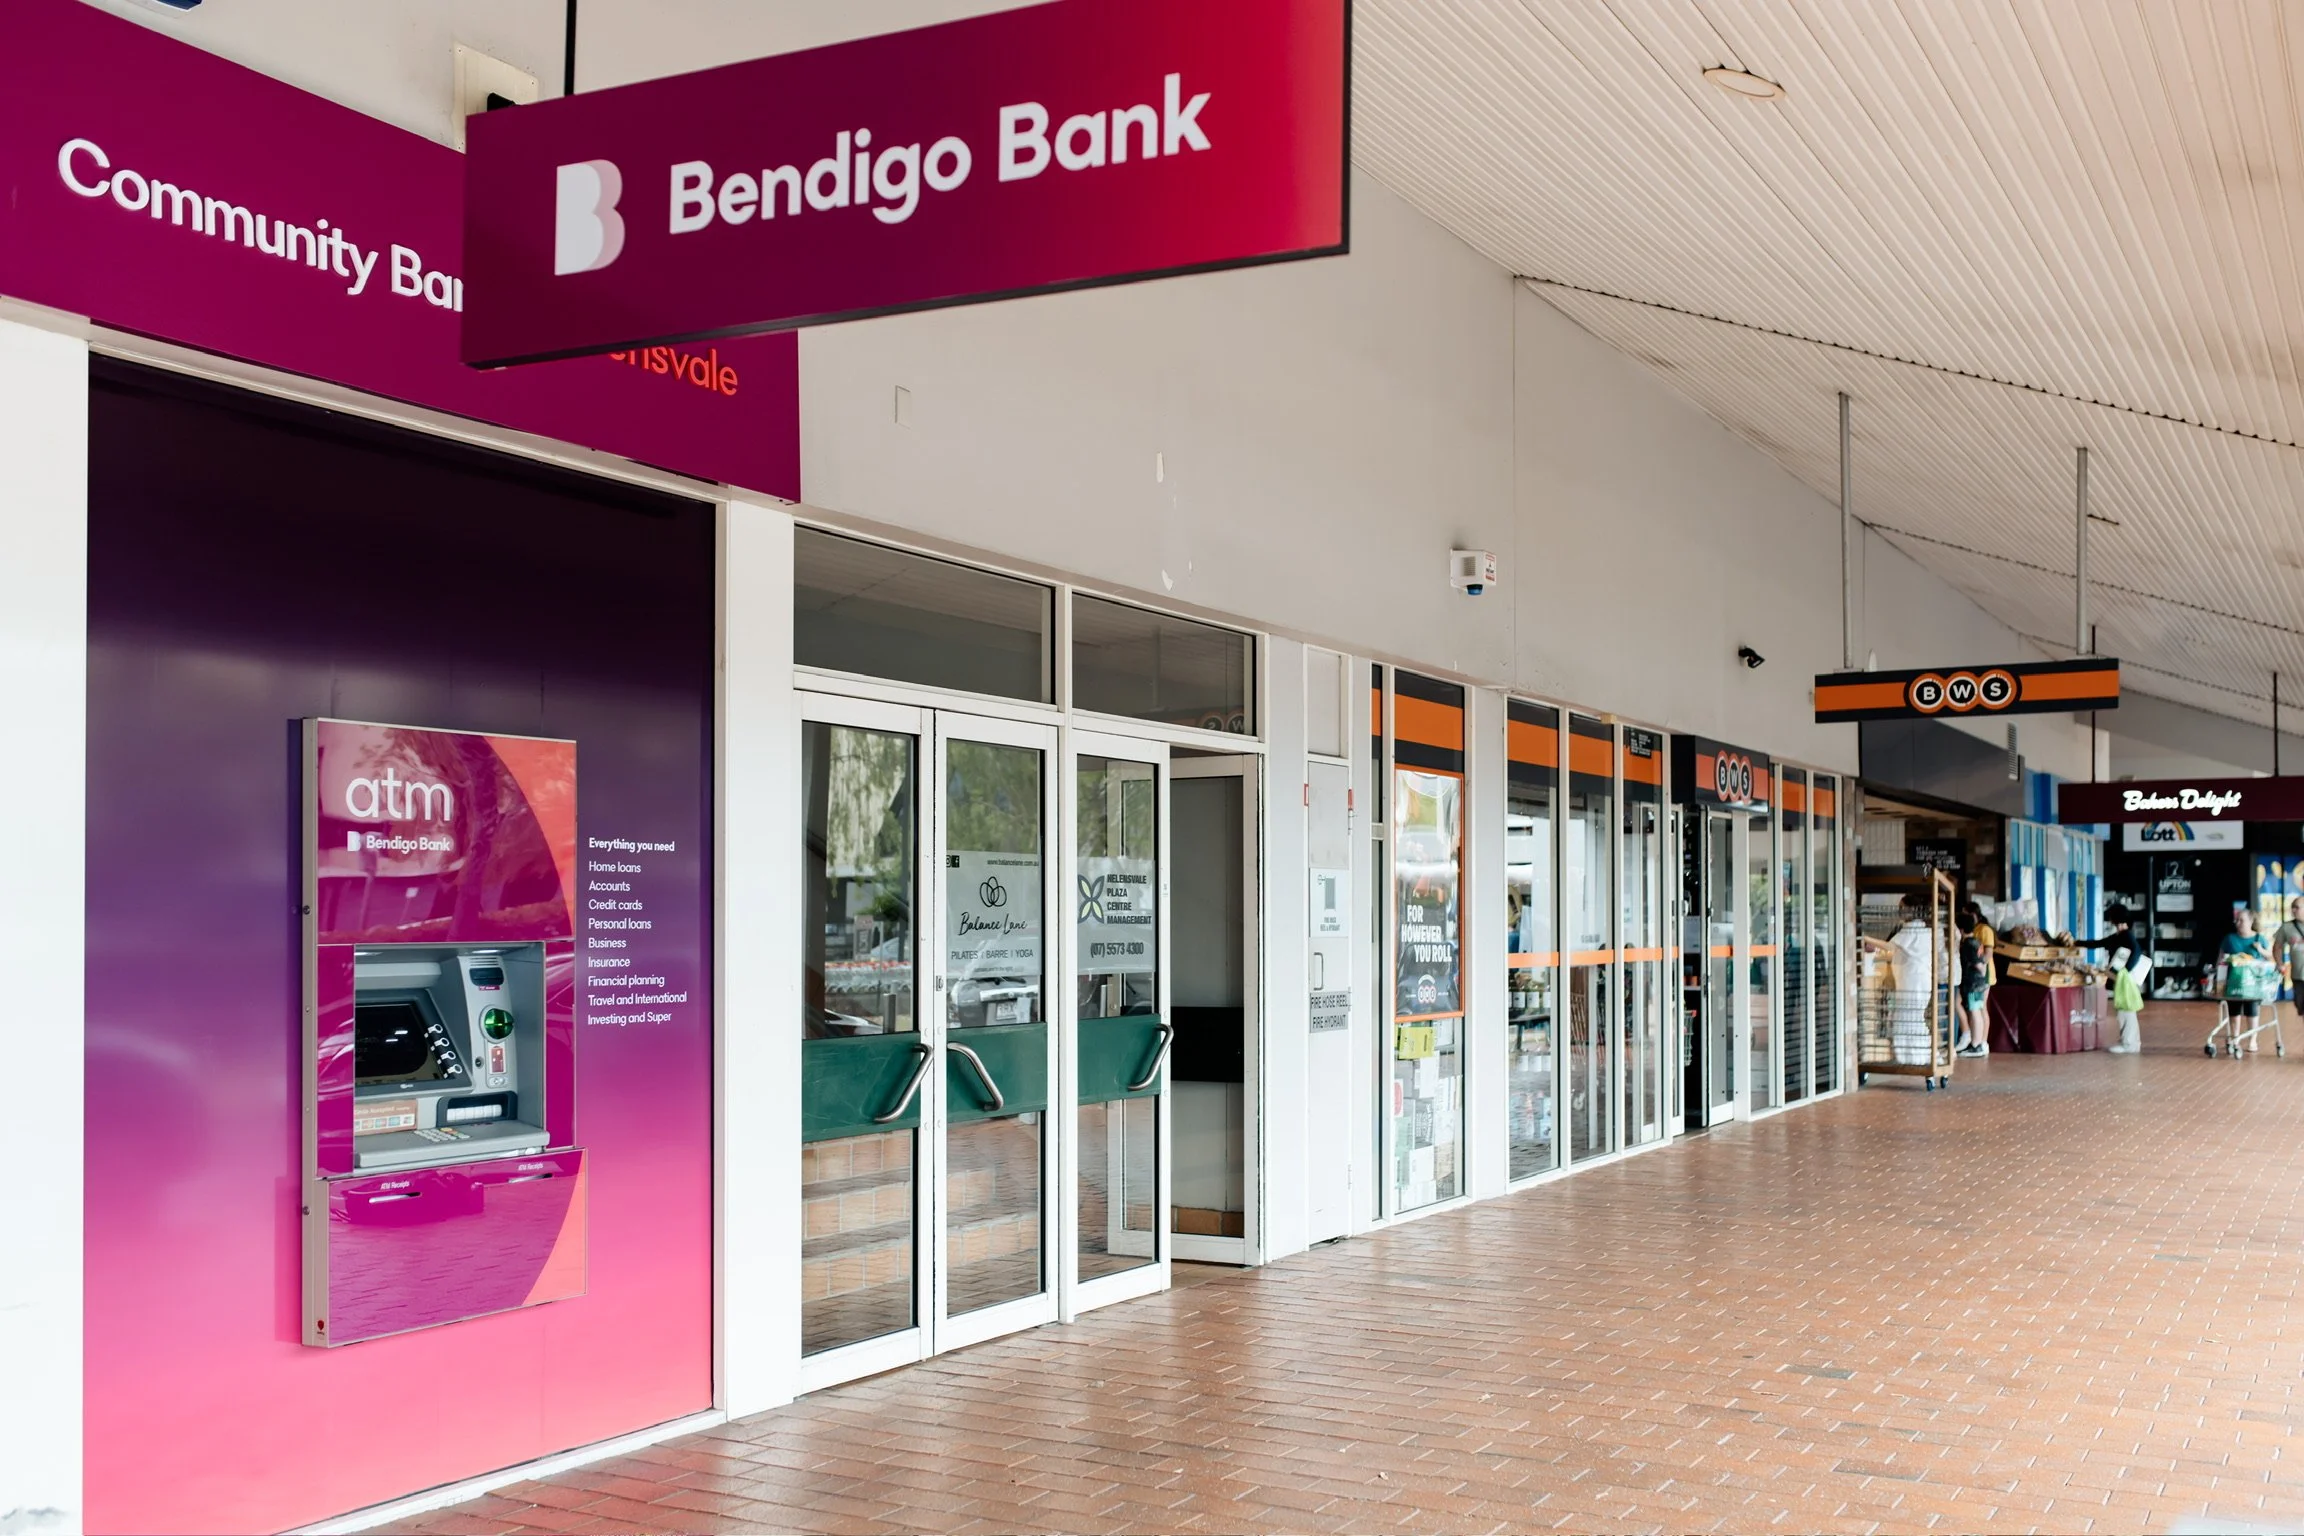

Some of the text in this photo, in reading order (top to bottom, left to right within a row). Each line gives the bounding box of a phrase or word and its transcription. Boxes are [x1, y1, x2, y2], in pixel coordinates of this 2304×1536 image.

[669, 128, 972, 234] Bendigo
[998, 73, 1211, 182] Bank
[57, 138, 378, 296] Community
[1923, 682, 2002, 701] BWS
[345, 768, 451, 822] atm
[2123, 789, 2242, 816] Bakers Delight
[366, 835, 451, 854] Bendigo Bank
[589, 837, 675, 853] Everything you need
[589, 861, 641, 873] Home loans
[589, 880, 630, 892] Accounts
[1107, 874, 1147, 884] HELENSVALE
[1107, 888, 1127, 897] PLAZA
[589, 899, 643, 911] Credit cards
[1107, 902, 1132, 911] CENTRE
[1107, 915, 1152, 925] MANAGEMENT
[1407, 905, 1424, 922] FOR
[588, 918, 652, 930] Personal loans
[957, 911, 1027, 936] Balance Lane
[1401, 925, 1442, 943] HOWEVER
[588, 937, 627, 949] Business
[1090, 941, 1144, 958] (07) 5573 4300
[951, 949, 1033, 960] PILATES BARRE YOGA
[1414, 945, 1452, 962] YOU ROLL
[588, 957, 631, 968] Insurance
[588, 975, 665, 988] Financial planning
[588, 992, 687, 1006] Travel and International
[1311, 994, 1348, 1008] FIRE HOSE REEL
[588, 1011, 672, 1026] Investing and Super
[1313, 1014, 1346, 1029] FIRE HYDRANT
